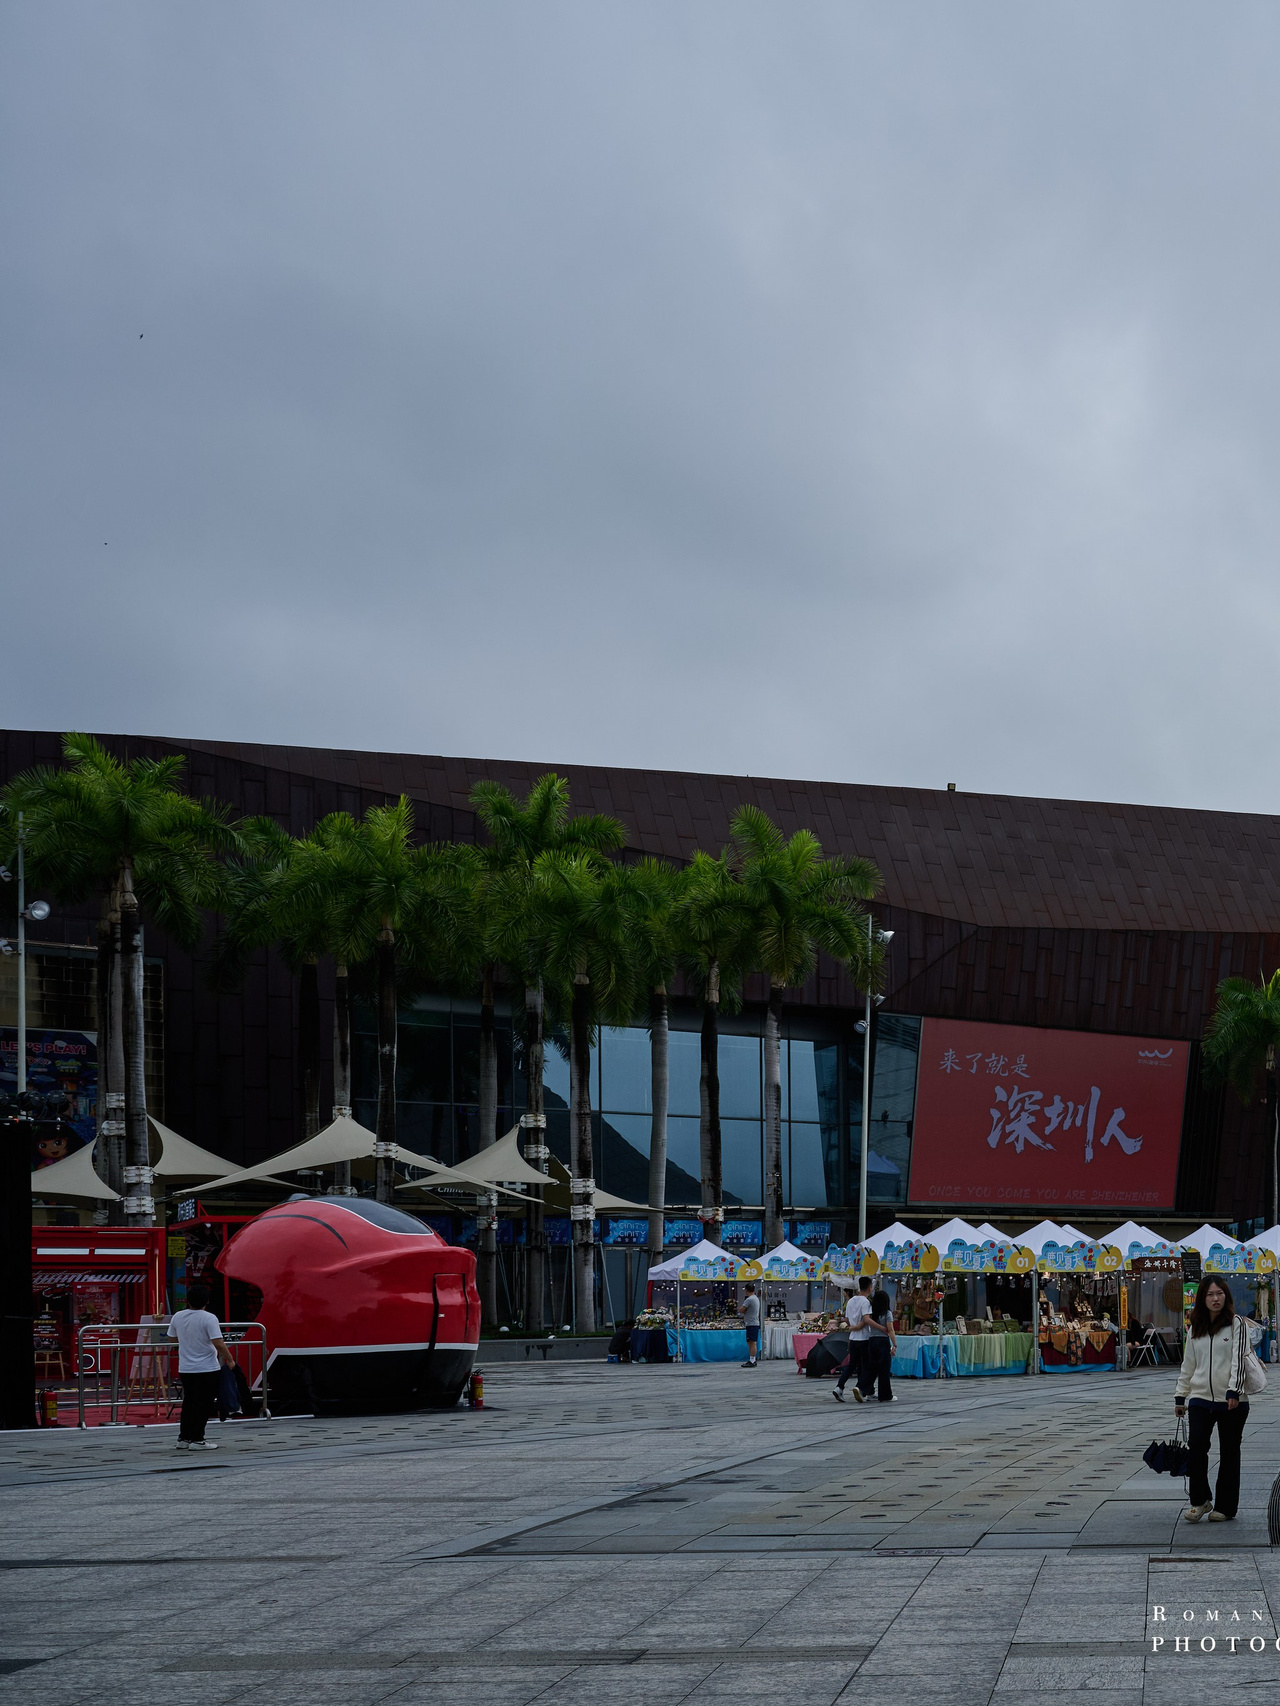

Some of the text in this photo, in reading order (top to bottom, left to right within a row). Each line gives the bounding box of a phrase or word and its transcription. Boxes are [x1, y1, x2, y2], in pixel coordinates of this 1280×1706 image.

[1, 1041, 87, 1055] LE'S PLAY!
[939, 1048, 1031, 1078] 来了就是
[986, 1084, 1144, 1164] 深圳人
[928, 1185, 1160, 1202] ONCE YOU COME YOU ARE SHENZHENER
[1016, 1257, 1029, 1268] 01
[1103, 1256, 1117, 1266] 02
[1261, 1259, 1272, 1268] 04
[745, 1268, 758, 1276] 29
